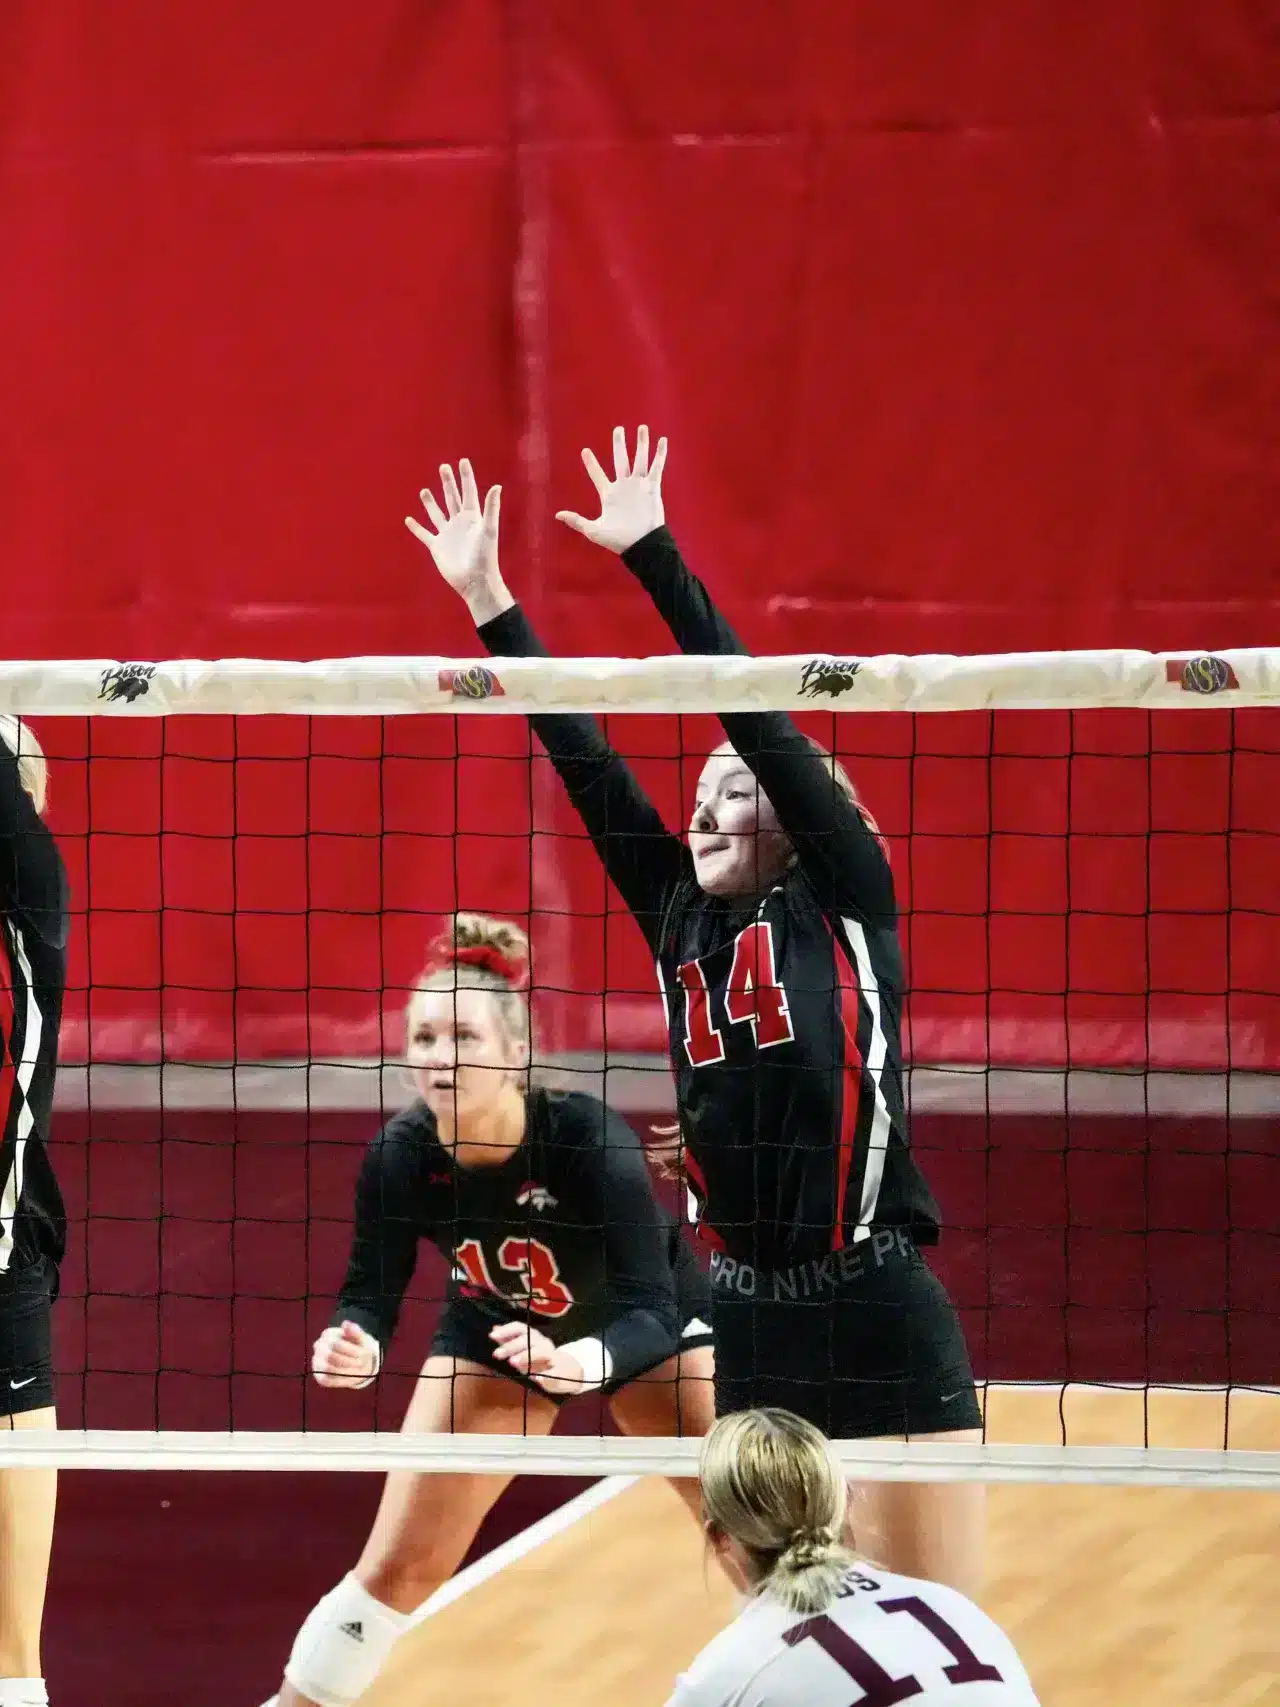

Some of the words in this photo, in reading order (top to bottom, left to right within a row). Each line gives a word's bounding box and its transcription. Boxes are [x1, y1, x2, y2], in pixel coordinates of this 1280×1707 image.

[97, 664, 158, 699] Bison
[797, 659, 863, 696] Bison
[676, 921, 796, 1068] 14
[454, 1236, 574, 1318] 13
[773, 1248, 866, 1302] NIKE
[781, 1595, 1005, 1707] 11
